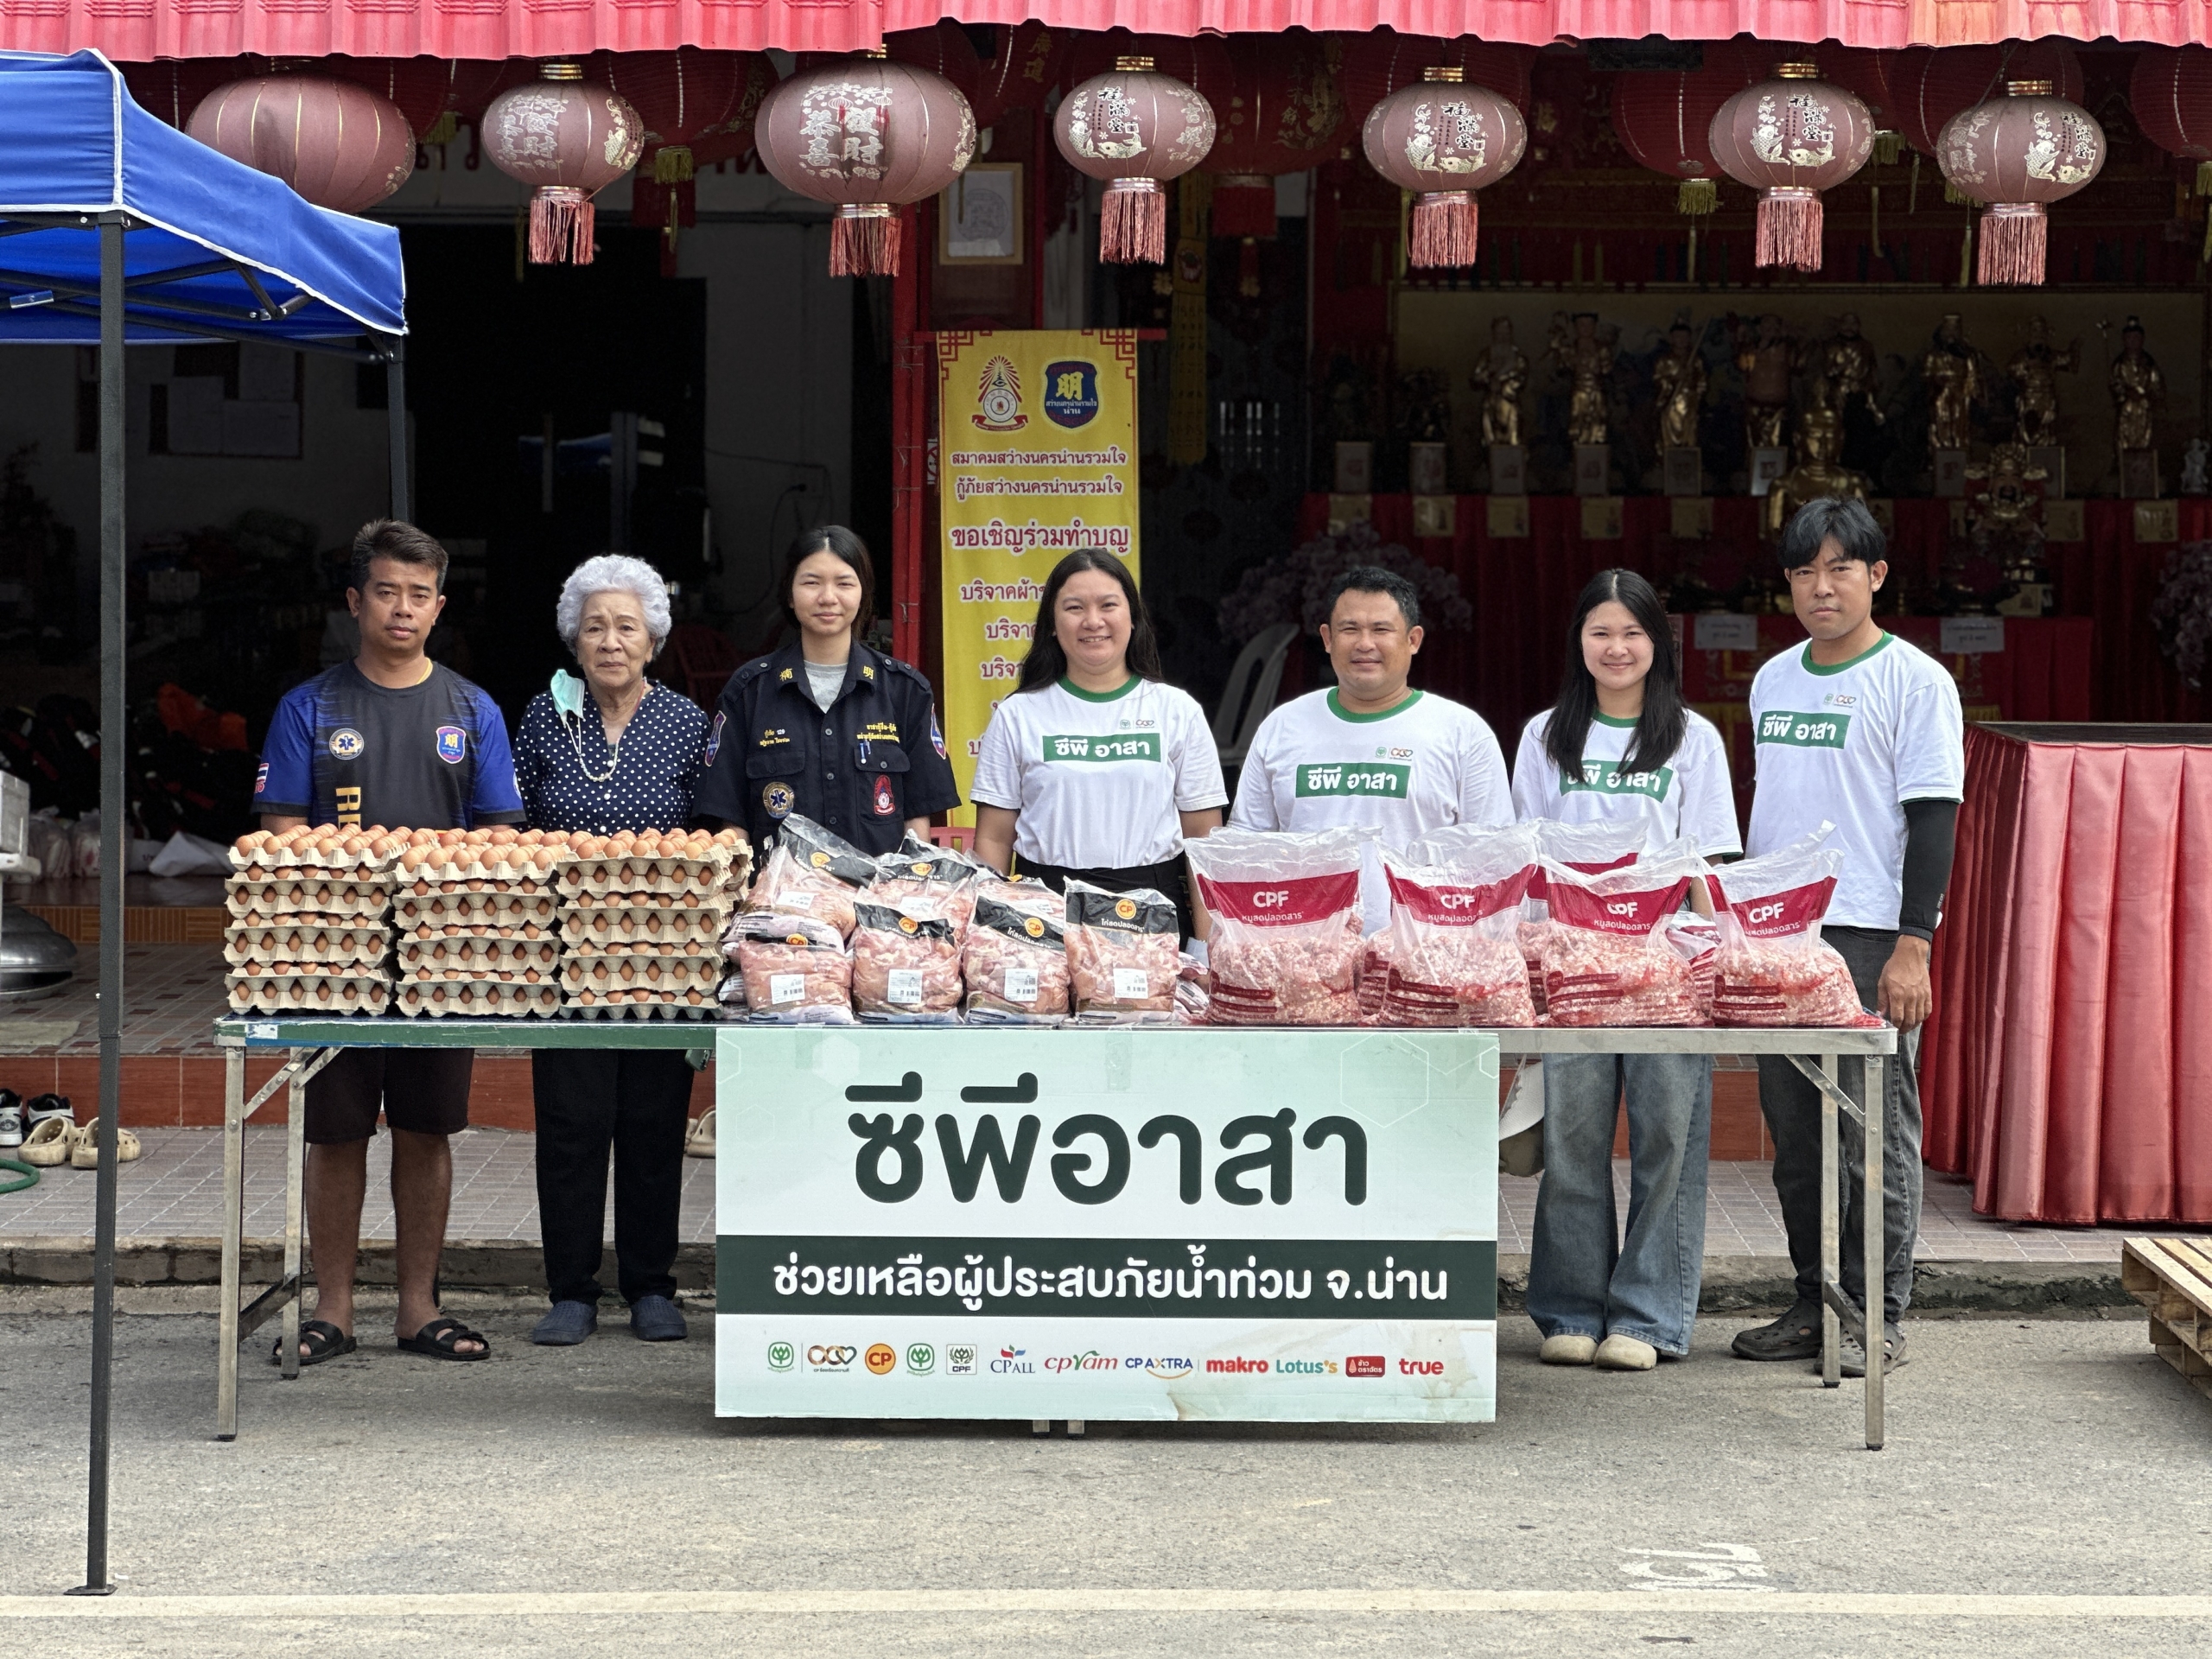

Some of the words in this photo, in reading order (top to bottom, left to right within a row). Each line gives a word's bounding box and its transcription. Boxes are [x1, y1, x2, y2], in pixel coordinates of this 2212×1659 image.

[951, 446, 1127, 465] สมาคมสว่างนครน่านรวมใจ
[956, 474, 1123, 500] กู้ภัยสว่างนครน่านรวมใจ
[950, 519, 1129, 553] ขอเชิญร่วมทำบุญ
[1762, 714, 1794, 738] ซีพี
[1795, 721, 1837, 741] อาสา
[1053, 737, 1090, 757] ซีพี
[1094, 740, 1151, 758] อาสา
[1307, 766, 1342, 791] ซีพี
[1346, 771, 1398, 791] อาสา
[1252, 890, 1289, 908] CPF
[1440, 893, 1476, 910] CPF
[1241, 910, 1302, 925] หมูสดปลอดสาร
[1606, 901, 1638, 918] CPF
[1749, 901, 1784, 924] CPF
[1593, 918, 1652, 931] หมูสดปลอดสาร
[844, 1071, 1368, 1207] ซีพีอาสา
[773, 1244, 1313, 1312] ช่วยเหลือผู้ประสบภัยน้ำท่วม
[1327, 1255, 1448, 1301] จ.น่าน
[868, 1351, 893, 1367] CP
[1205, 1356, 1269, 1374] makro
[1275, 1359, 1338, 1374] Lotus's
[1398, 1357, 1445, 1376] true
